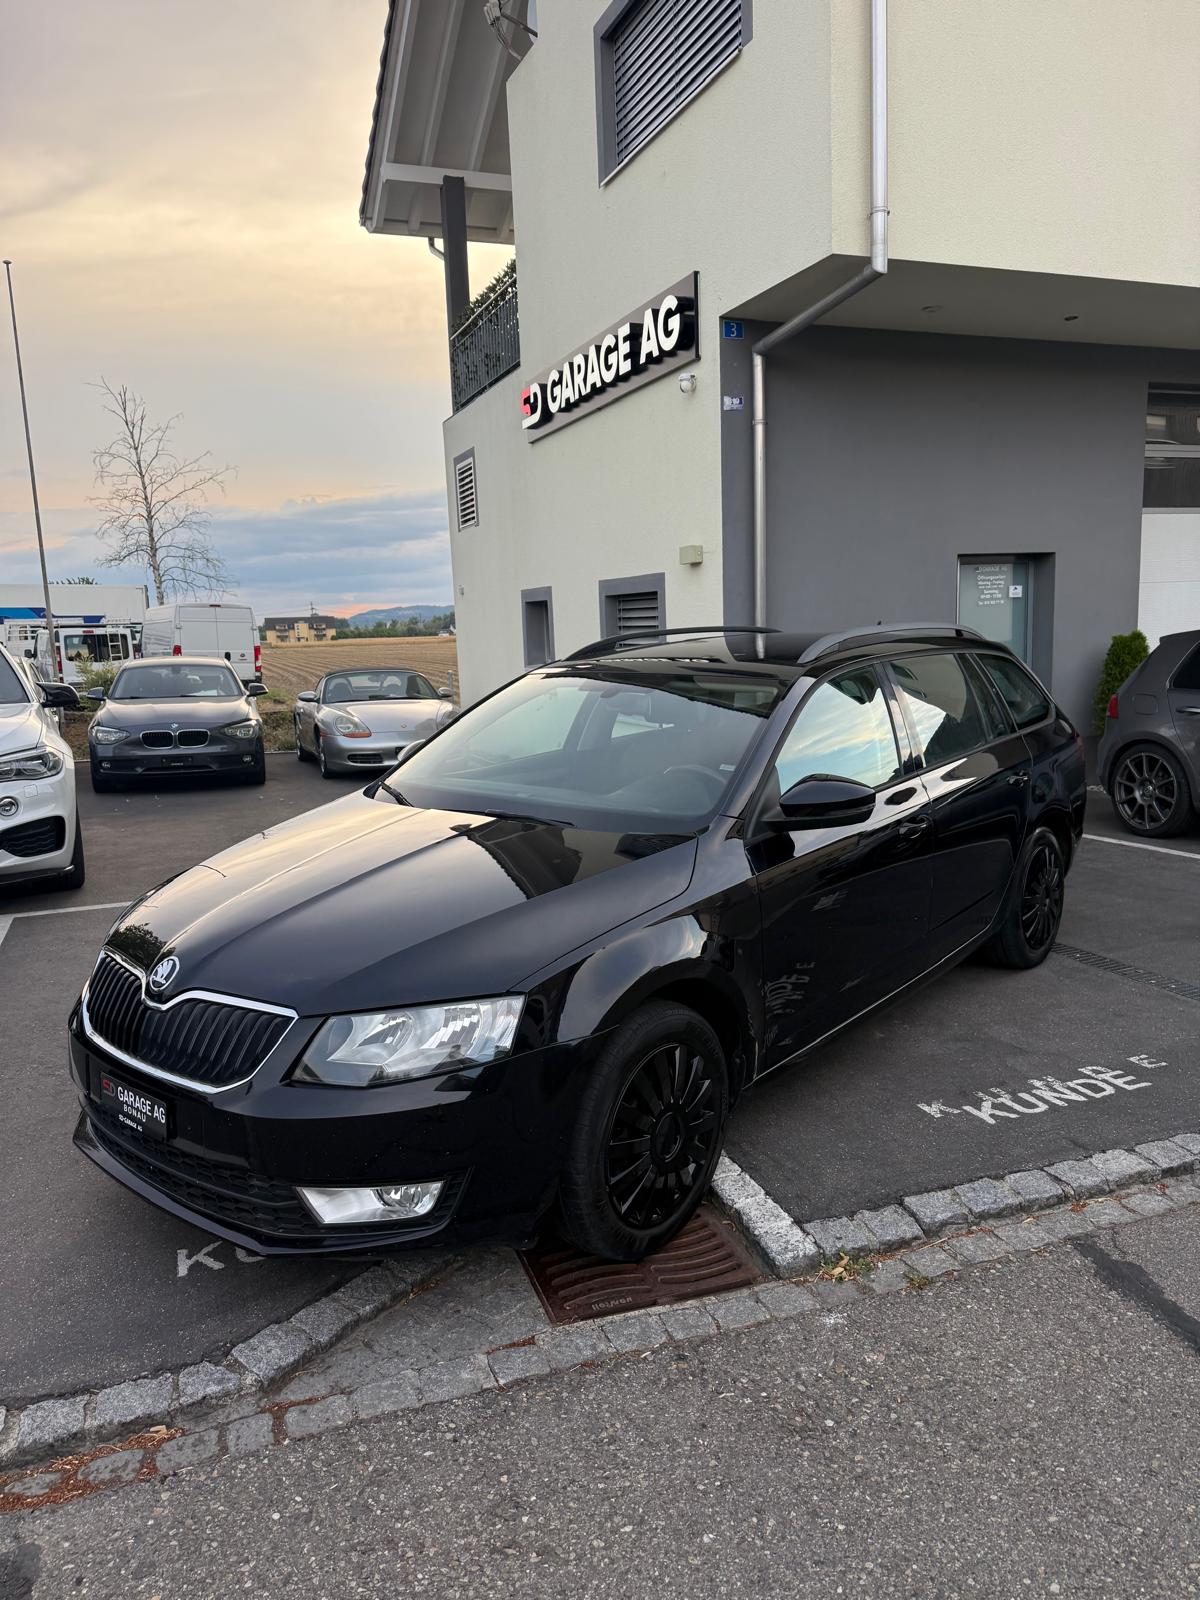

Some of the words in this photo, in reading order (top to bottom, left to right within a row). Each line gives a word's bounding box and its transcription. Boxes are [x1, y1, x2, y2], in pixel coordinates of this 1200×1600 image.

[730, 322, 737, 337] 3
[546, 322, 632, 415] GARAGE
[639, 294, 681, 365] AG
[117, 1086, 152, 1116] GARAGE
[153, 1104, 166, 1124] AG
[123, 1103, 147, 1123] BONAU
